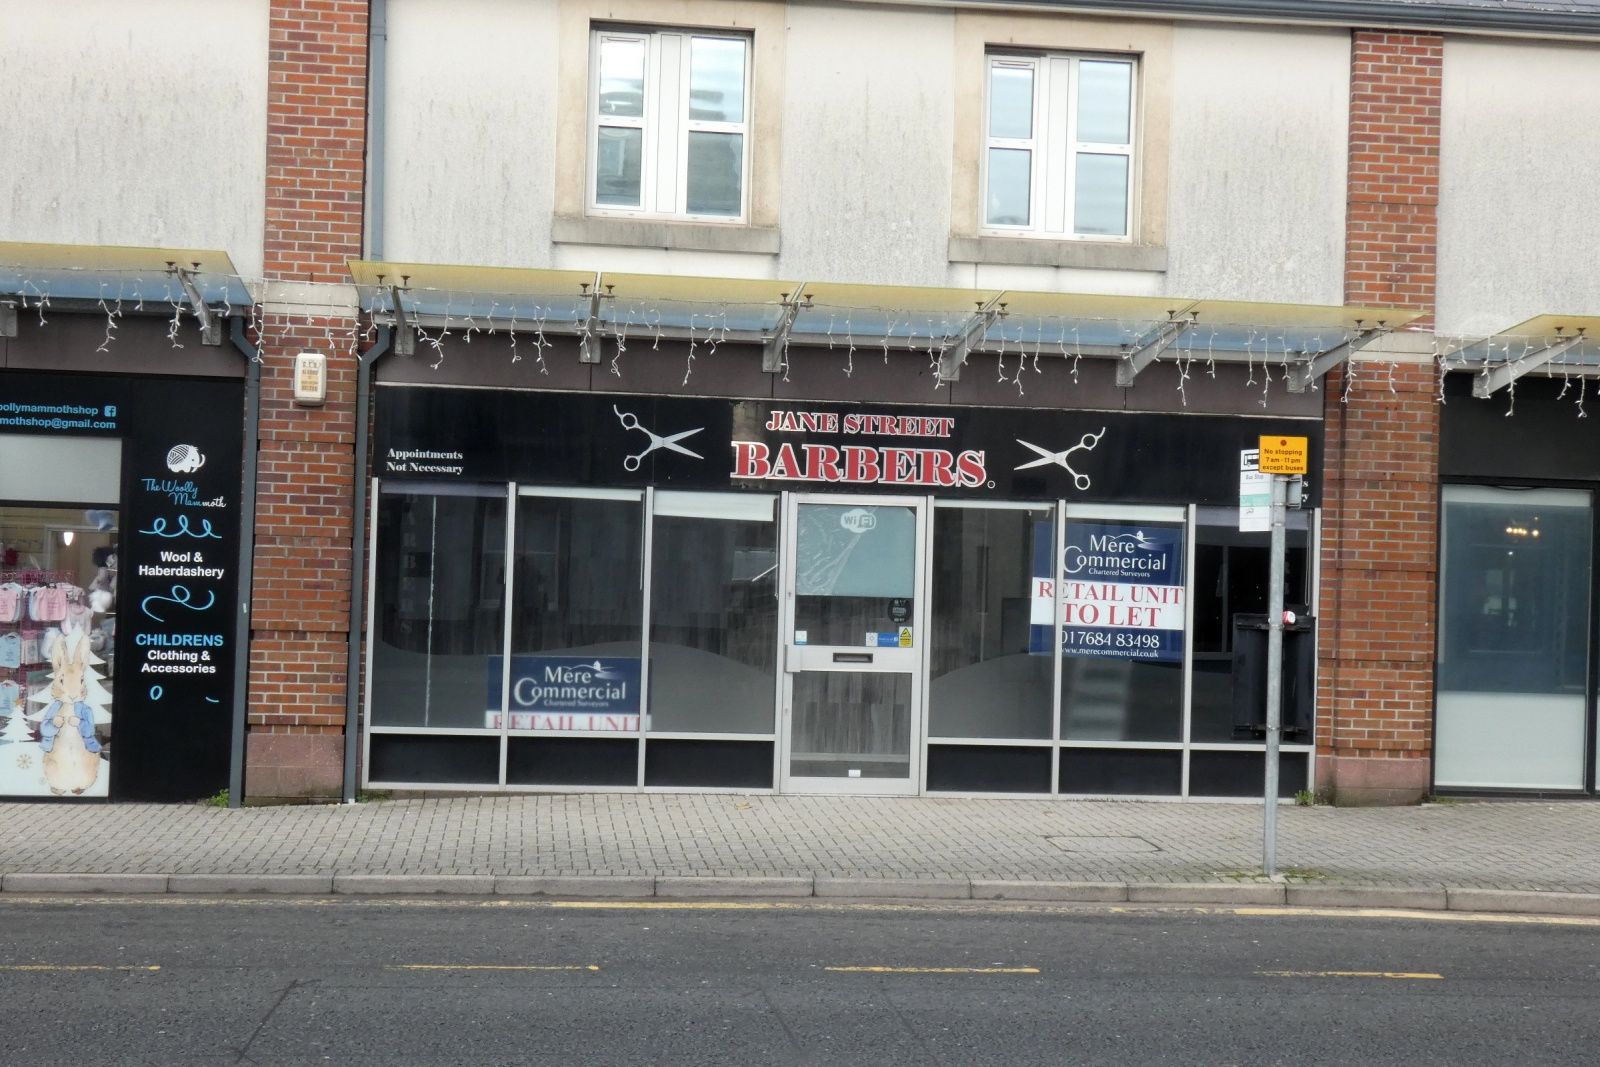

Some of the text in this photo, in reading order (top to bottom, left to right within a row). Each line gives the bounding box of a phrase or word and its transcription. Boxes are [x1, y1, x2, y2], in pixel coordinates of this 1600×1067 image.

[765, 410, 954, 438] JANE STREET
[387, 448, 463, 460] Appointments
[1275, 448, 1303, 456] stopping
[386, 461, 464, 475] Not Necessary
[141, 478, 198, 499] The Woolly
[168, 492, 226, 508] Mammoth
[1090, 534, 1135, 553] Mere
[160, 551, 203, 563] Wool &
[1064, 545, 1166, 573] Commercial
[138, 565, 225, 579] Haberdashery
[1088, 567, 1151, 578] Chartered Surveyors
[1131, 586, 1184, 604] UNIT
[1063, 602, 1161, 627] TO LET
[135, 634, 224, 646] CHILDRENS
[1116, 633, 1160, 648] 83498
[147, 650, 211, 662] Clothing &
[141, 663, 216, 674] Accessories
[545, 666, 592, 684] Mere
[514, 677, 626, 706] Commercial
